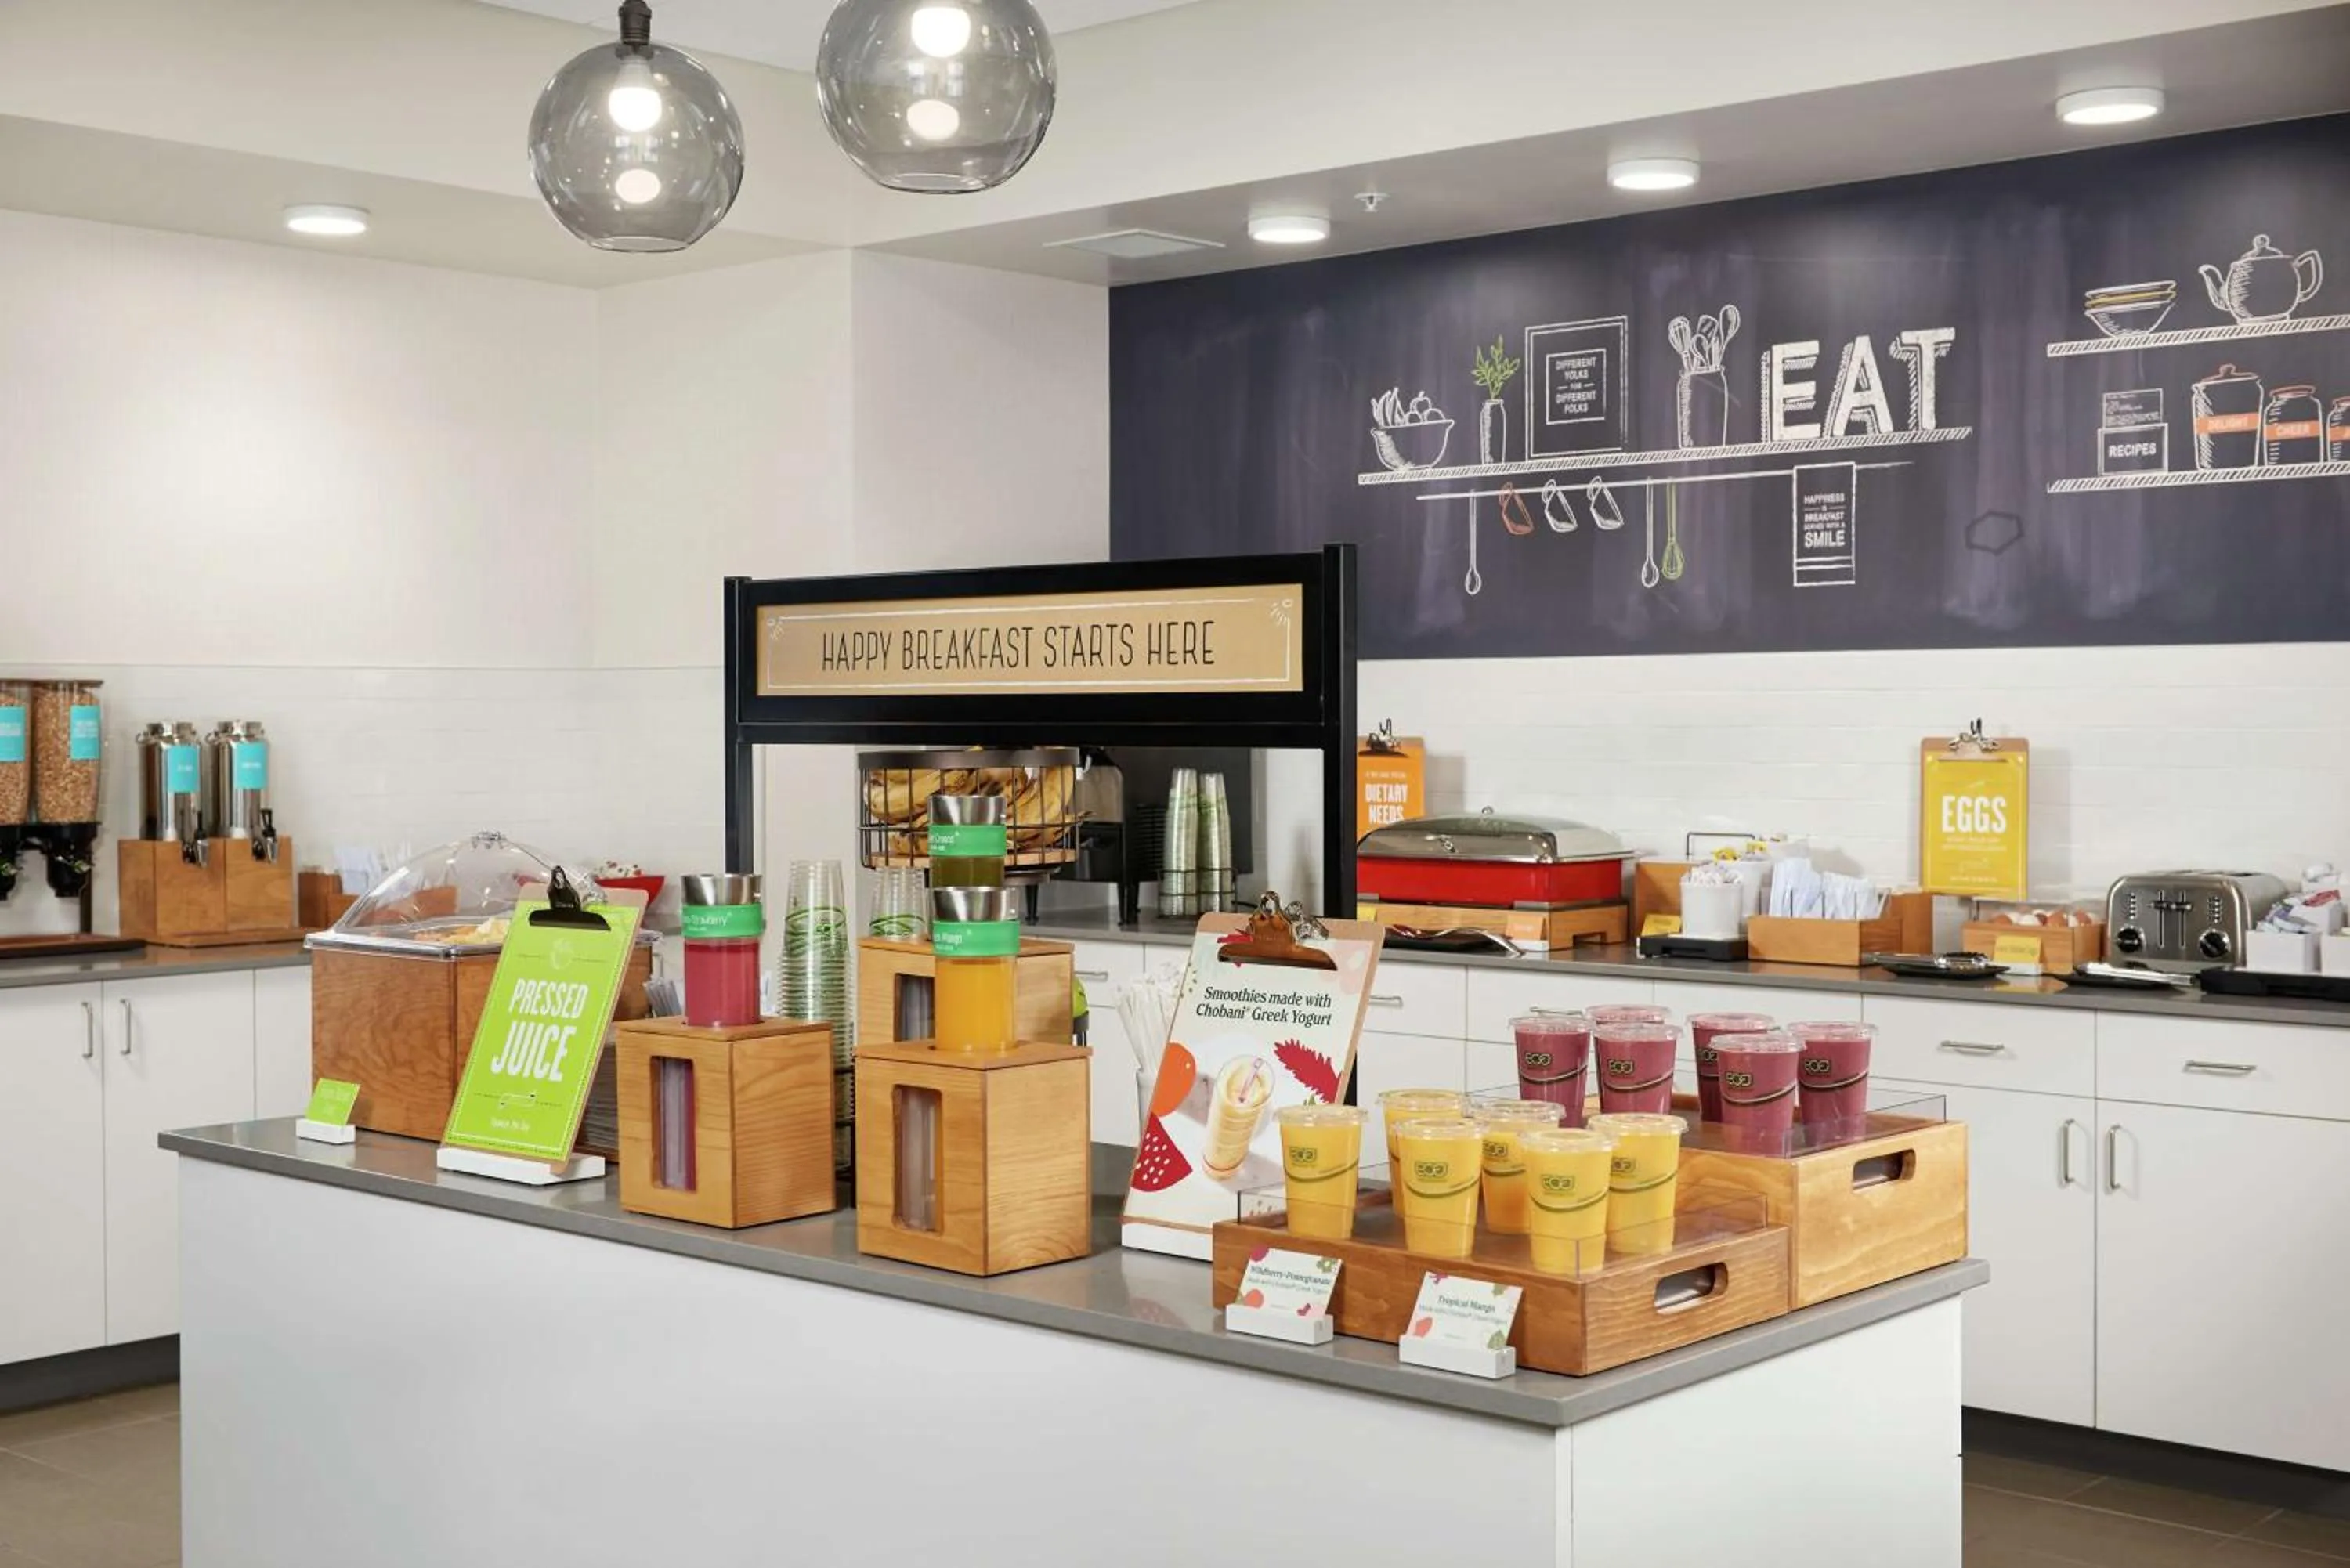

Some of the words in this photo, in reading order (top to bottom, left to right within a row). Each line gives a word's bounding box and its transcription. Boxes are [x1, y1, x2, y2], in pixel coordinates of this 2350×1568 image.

[1556, 356, 1596, 370] DIFFERENT
[1761, 327, 1955, 443] EAT
[1556, 390, 1596, 404] DIFFERENT
[1564, 403, 1588, 414] FOLKS
[2108, 443, 2157, 457] RECIPES
[1804, 493, 1845, 504] HAPPINESS
[1804, 511, 1845, 522] BREAKFAST
[1804, 530, 1846, 548] SMILE
[822, 630, 892, 672] HAPPY
[902, 626, 1033, 670] BREAKFAST
[1043, 622, 1134, 668] STARTS
[1148, 620, 1216, 666] HERE
[1365, 783, 1408, 803] DIETARY
[1368, 804, 1404, 825] NEEDS
[1942, 795, 2007, 834] EGGS
[508, 978, 588, 1019] PRESSED
[1204, 986, 1267, 1003] Smoothies
[1268, 992, 1303, 1006] made
[1306, 993, 1332, 1008] with
[1252, 1006, 1289, 1023] Greek
[1292, 1010, 1332, 1028] Yogurt
[490, 1021, 577, 1082] JUICE
[1437, 1295, 1470, 1308] Tropical
[1470, 1300, 1495, 1313] Mango
